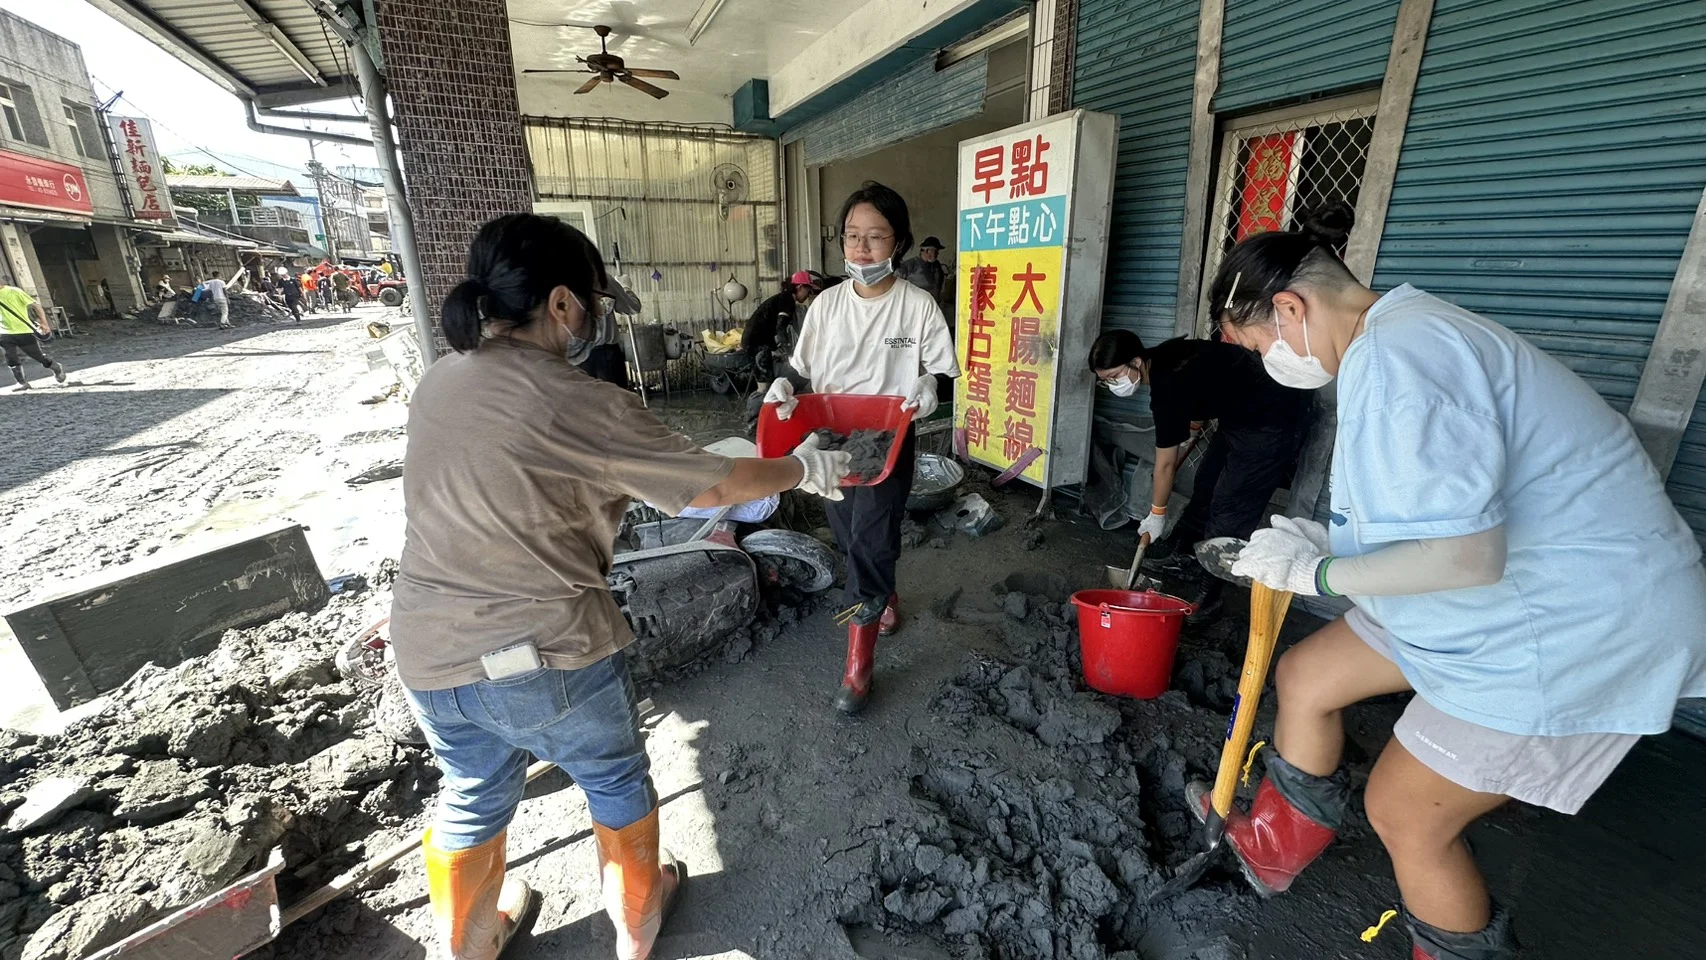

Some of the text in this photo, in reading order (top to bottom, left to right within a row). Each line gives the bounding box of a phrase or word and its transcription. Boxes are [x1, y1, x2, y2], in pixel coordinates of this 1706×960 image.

[965, 202, 1058, 249] 下午點心
[971, 133, 1051, 204] 早點
[966, 263, 998, 450] 蒙古蛋餅
[1003, 261, 1047, 467] 大腸麵線
